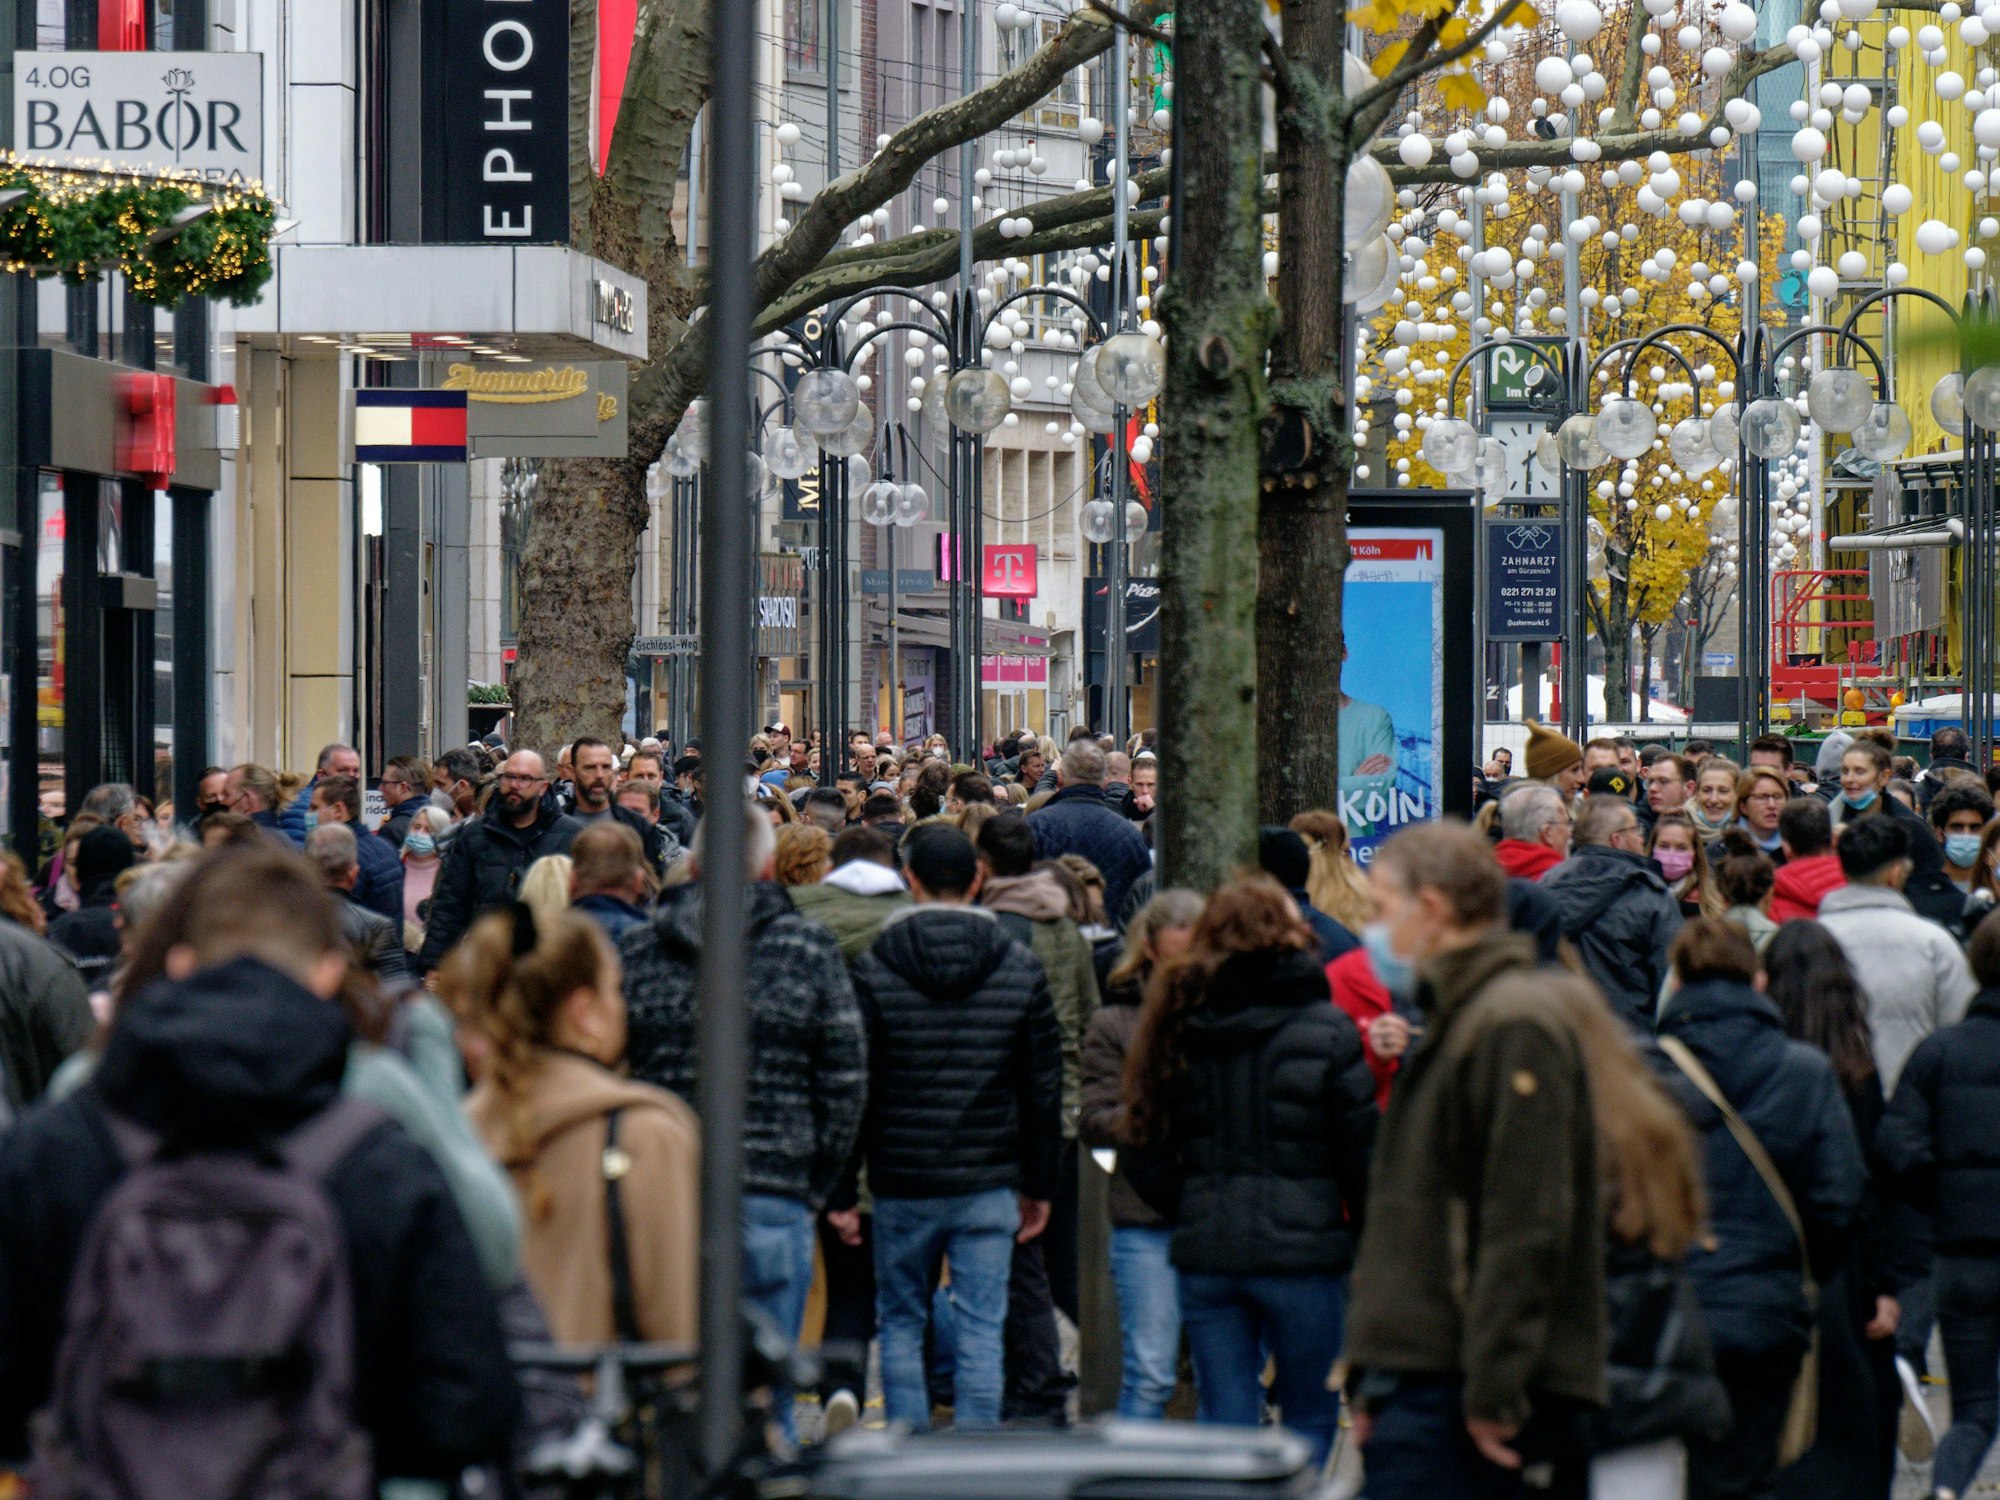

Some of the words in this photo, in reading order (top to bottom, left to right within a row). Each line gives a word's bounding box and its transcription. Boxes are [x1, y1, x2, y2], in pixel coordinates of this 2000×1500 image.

[25, 66, 91, 89] 4.OG
[483, 0, 533, 237] EPHO
[27, 99, 249, 153] BABOR
[1359, 545, 1381, 555] Köln
[1501, 556, 1556, 566] ZAHNARZT
[1519, 566, 1551, 574] Gürzenich
[1501, 587, 1519, 597] 0221
[1520, 587, 1534, 597] 271
[1535, 587, 1544, 597] 21
[1545, 587, 1556, 597] 20
[1507, 619, 1544, 627] Quatermarkt
